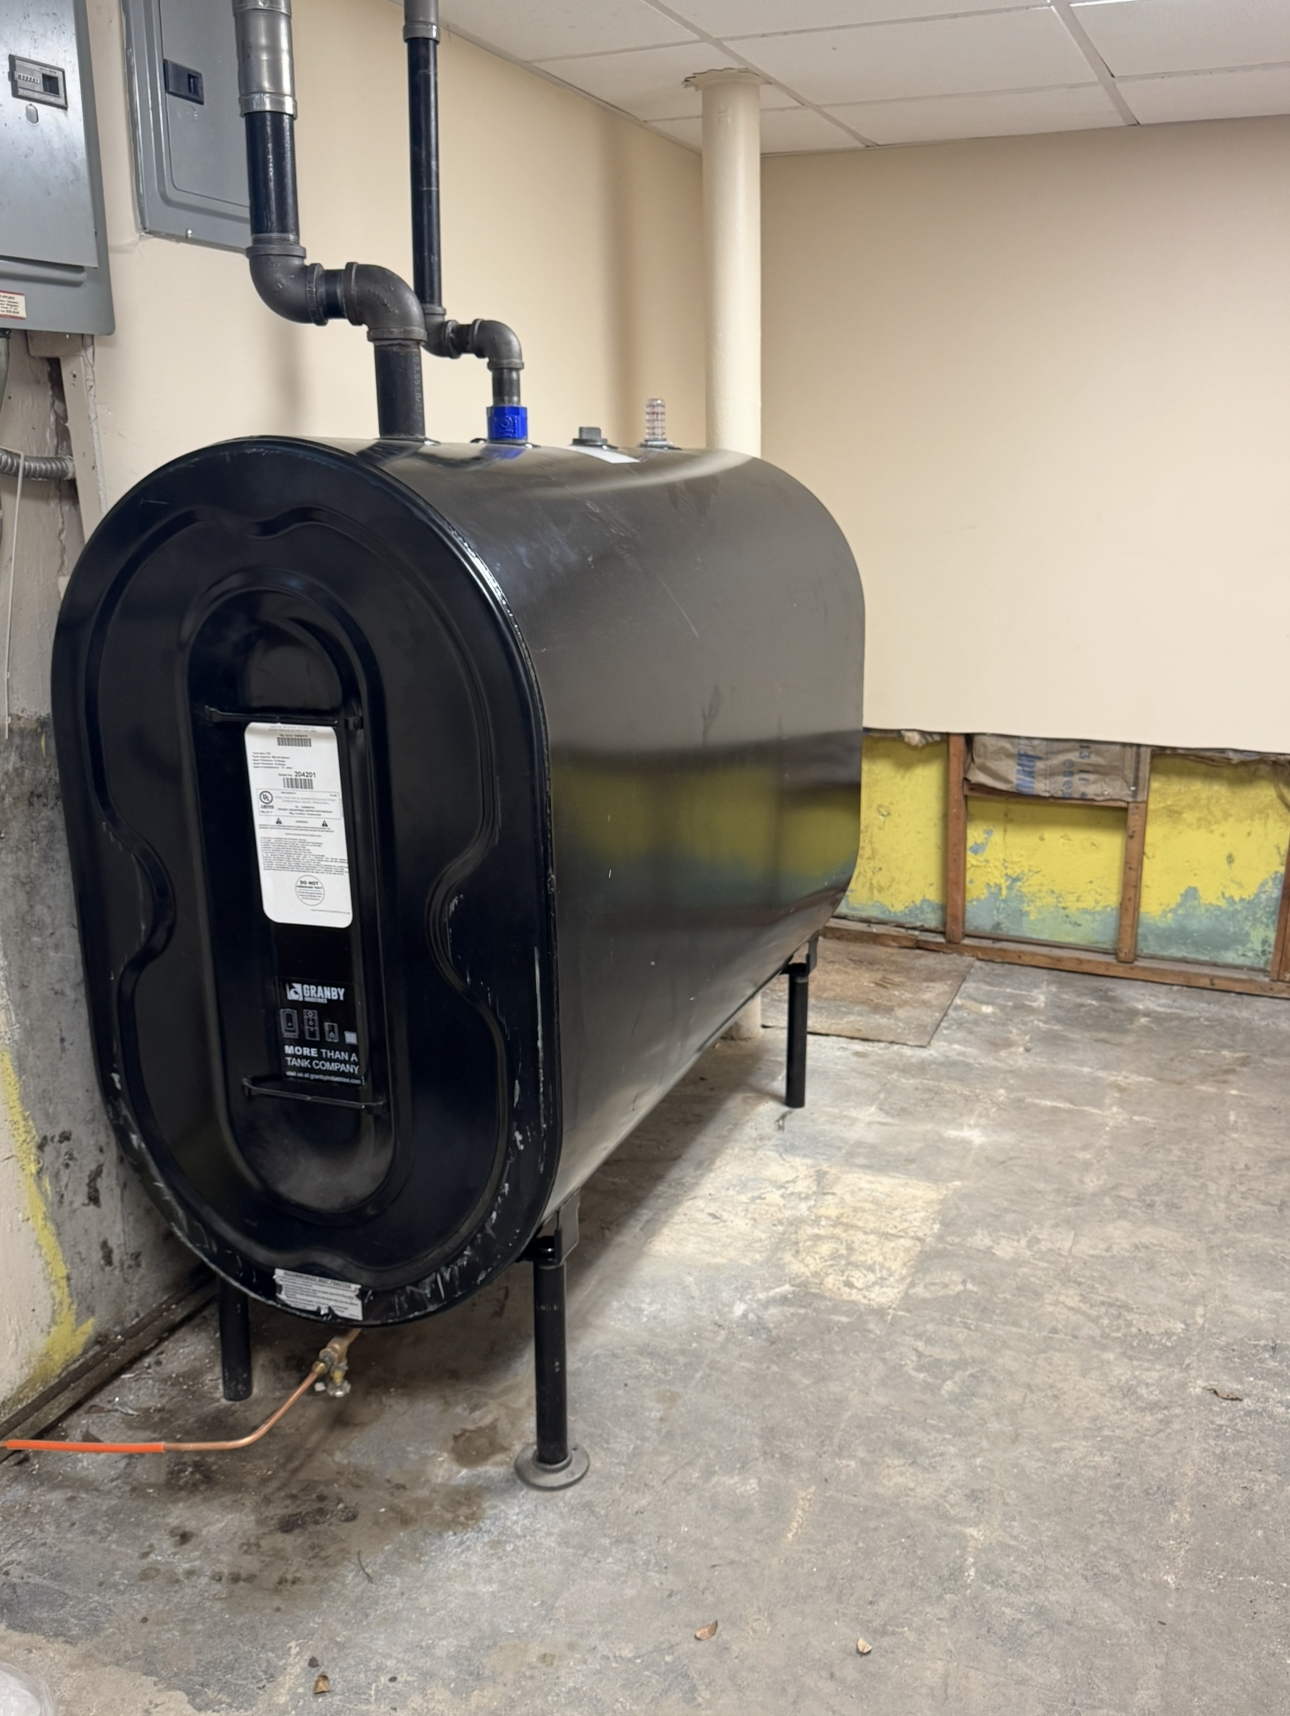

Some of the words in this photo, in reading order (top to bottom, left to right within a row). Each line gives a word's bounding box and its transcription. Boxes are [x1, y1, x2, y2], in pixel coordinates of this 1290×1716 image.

[294, 770, 316, 778] 204201
[302, 984, 345, 1001] GRANBY
[284, 1045, 318, 1057] MORE
[320, 1048, 349, 1060] THAN
[350, 1052, 358, 1062] A
[285, 1056, 312, 1068] TANK
[312, 1060, 359, 1075] COMPANY
